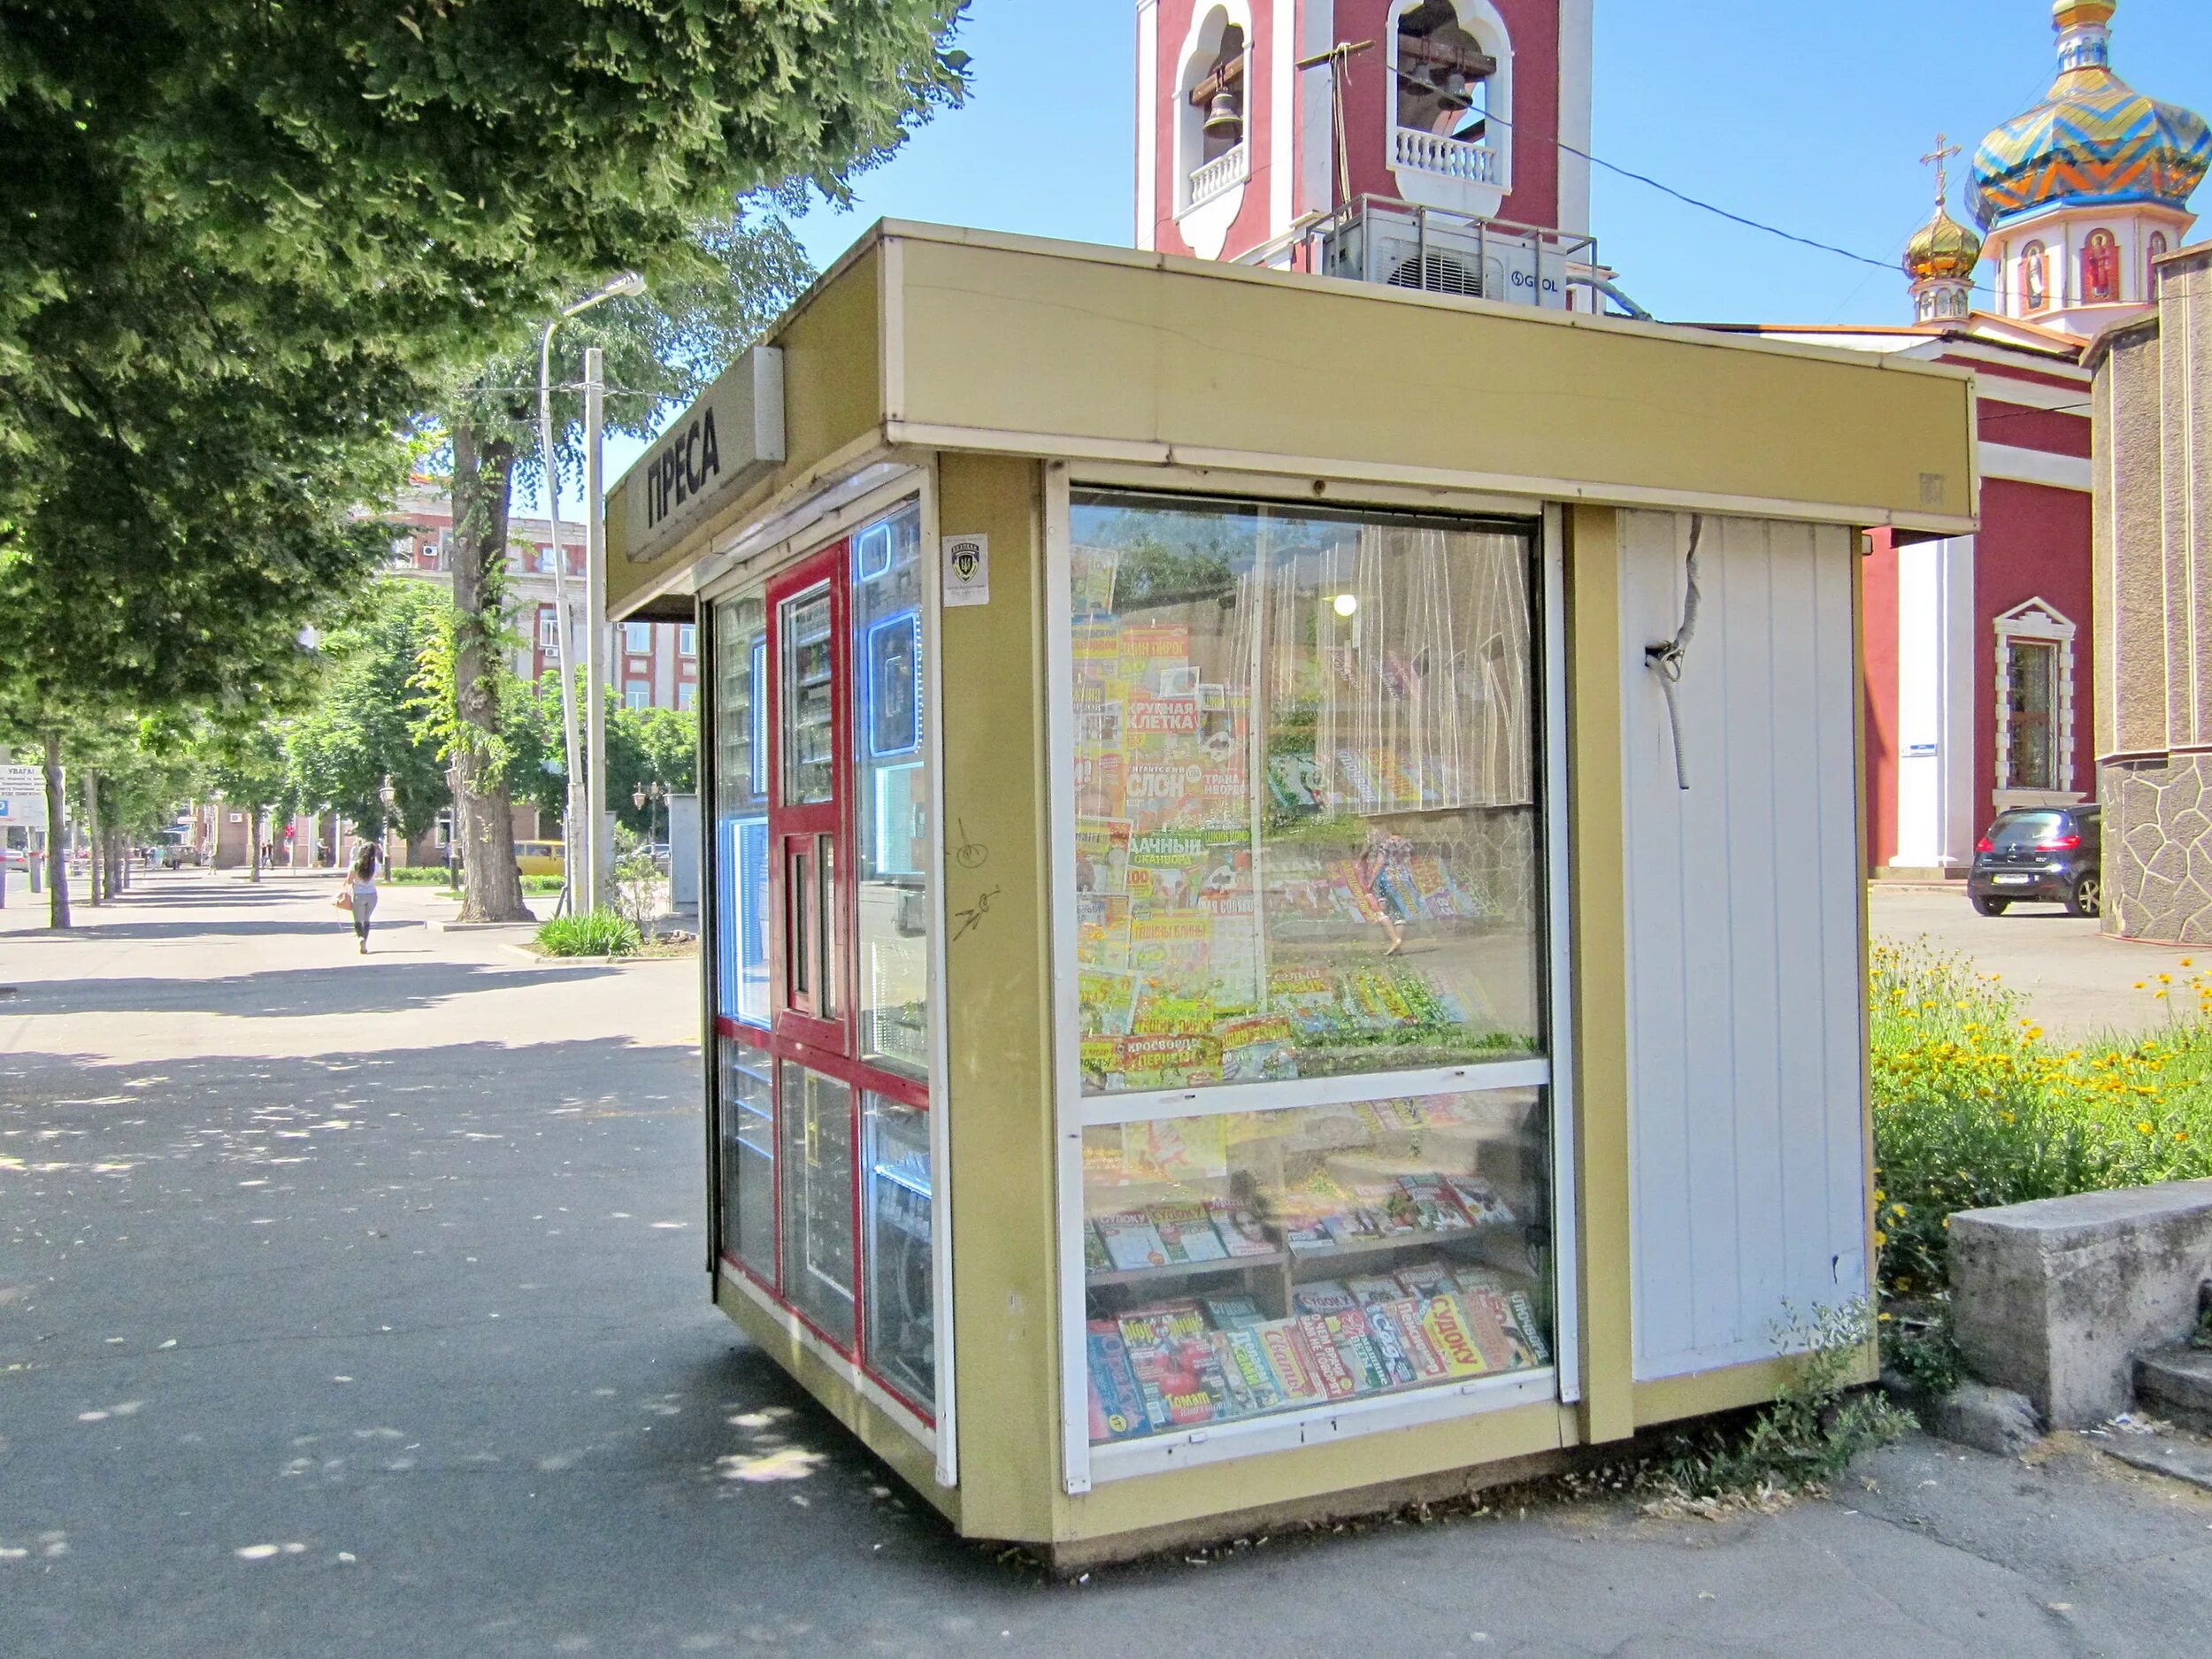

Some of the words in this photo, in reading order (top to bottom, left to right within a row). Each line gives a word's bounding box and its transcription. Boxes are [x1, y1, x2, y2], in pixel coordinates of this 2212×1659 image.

[648, 406, 720, 529] ПРЕСА
[1130, 703, 1194, 715] КРУПНАЯ
[1127, 715, 1194, 728] КЛЕТКА
[1126, 773, 1185, 797] СЛОН
[1134, 855, 1192, 864] СКАНВОРД
[1101, 1212, 1148, 1225] СУДОКУ
[1430, 1297, 1478, 1364] СУДОКУ
[1309, 1338, 1322, 1352] НЕ
[1164, 1391, 1210, 1409] Томат
